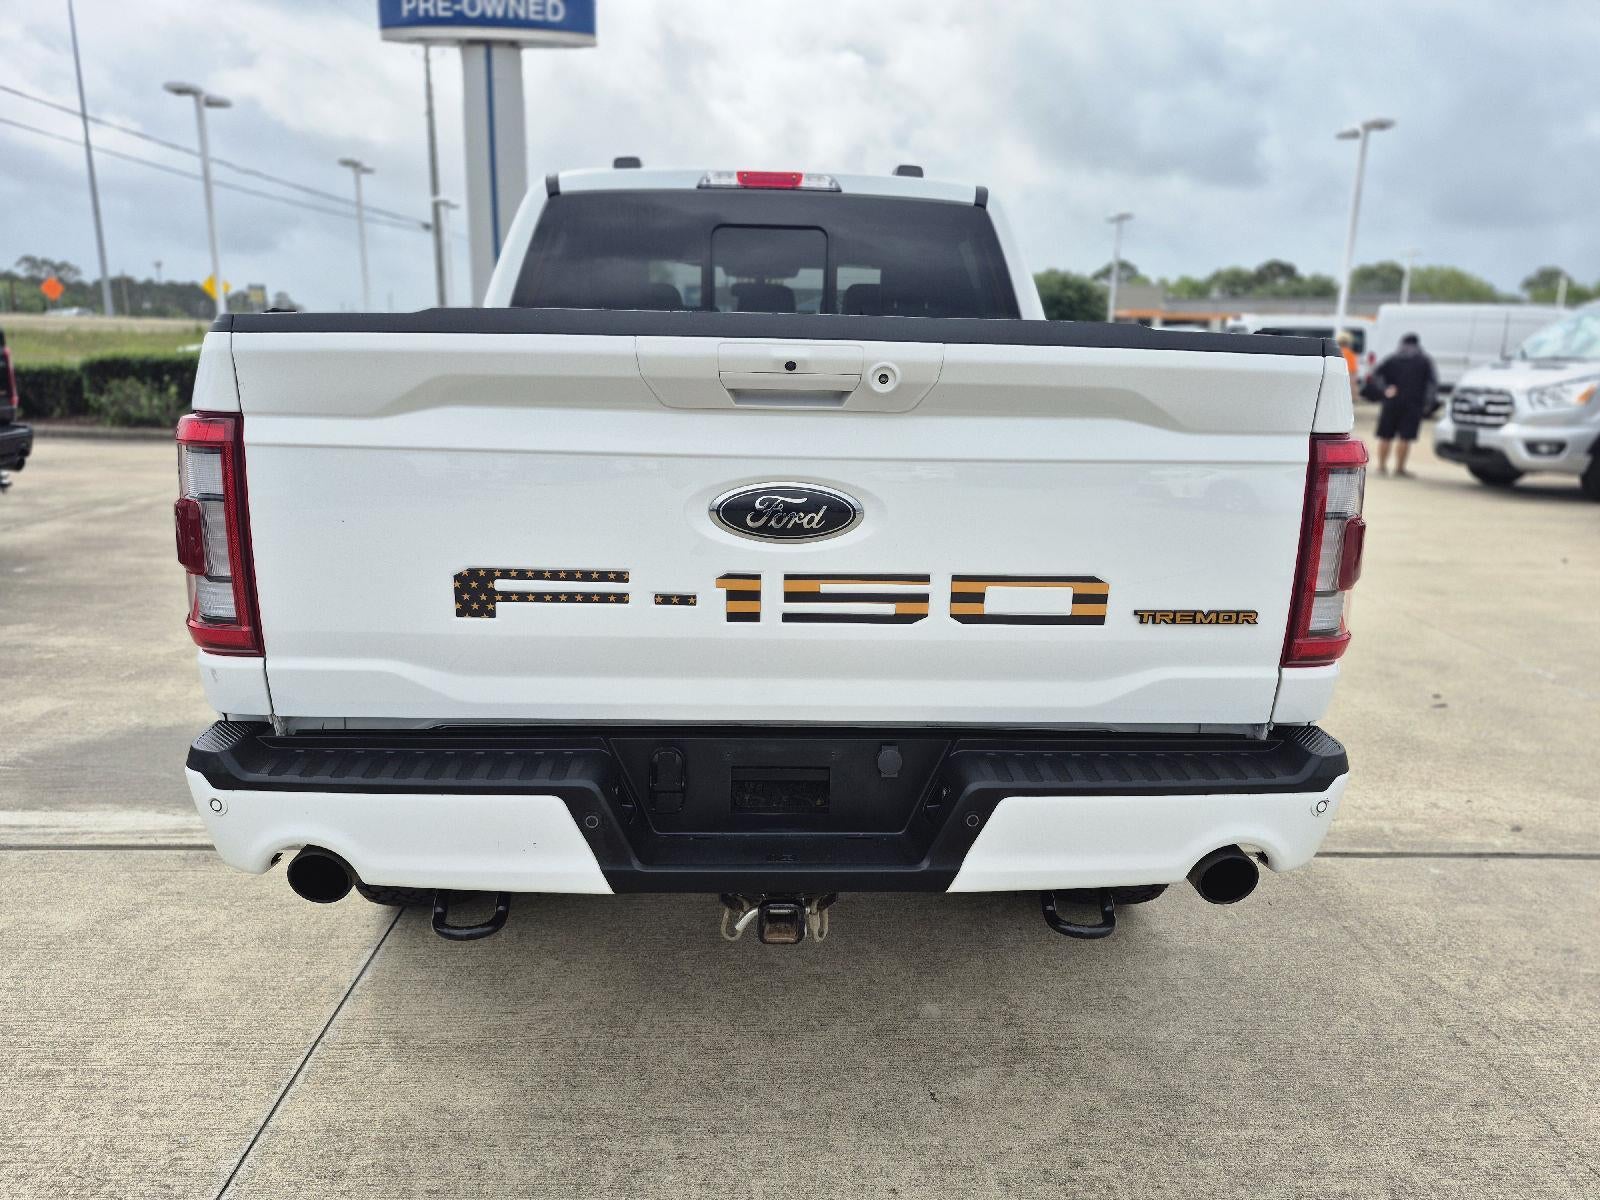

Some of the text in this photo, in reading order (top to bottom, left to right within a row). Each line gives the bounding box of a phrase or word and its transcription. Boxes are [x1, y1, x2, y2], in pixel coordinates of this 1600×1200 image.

[401, 0, 566, 22] PRE-OWNED
[746, 495, 827, 529] Ford
[453, 567, 1109, 626] F-150
[1134, 610, 1259, 625] TREMOR
